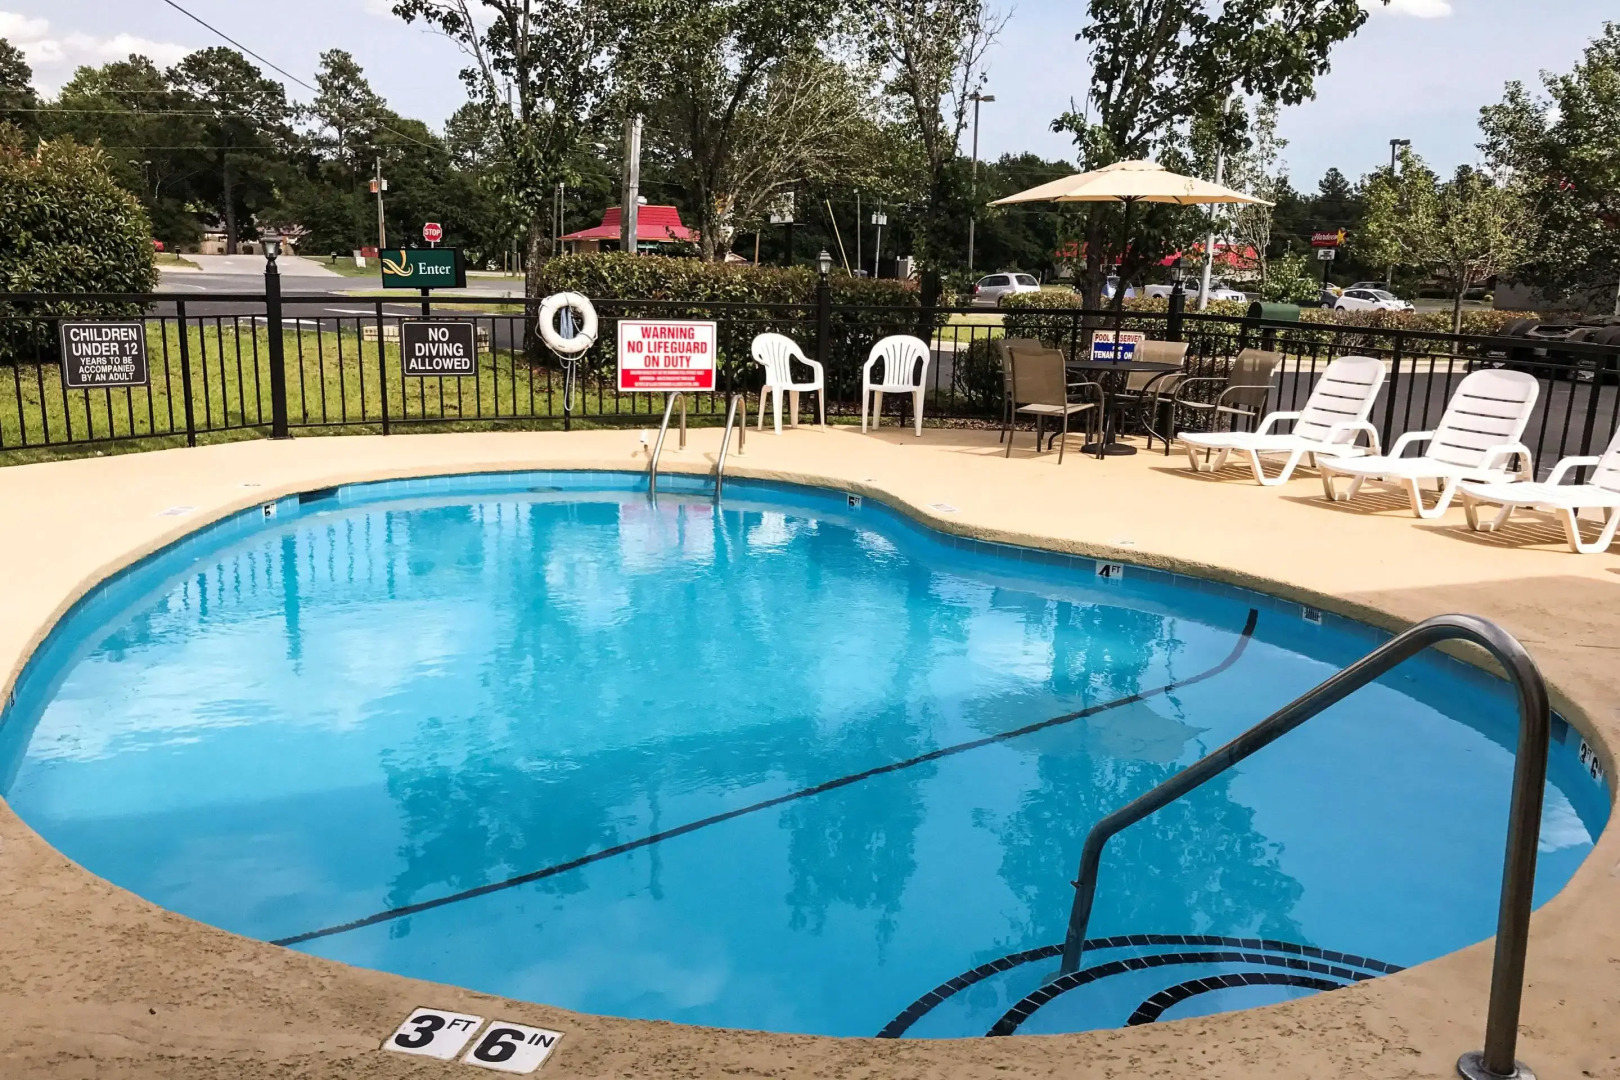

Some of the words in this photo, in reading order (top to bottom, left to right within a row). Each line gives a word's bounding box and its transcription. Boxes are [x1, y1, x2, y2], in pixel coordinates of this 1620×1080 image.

[424, 228, 441, 236] STOP
[418, 262, 451, 275] Enter
[70, 328, 138, 342] CHILDREN
[428, 328, 449, 342] NO
[641, 326, 695, 340] WARNING
[1095, 333, 1110, 342] POOL
[72, 343, 120, 356] UNDER
[124, 343, 138, 355] 12
[415, 343, 464, 356] DIVING
[627, 340, 643, 353] NO
[647, 341, 707, 354] LIFEGUARD
[109, 357, 120, 365] TO
[122, 356, 133, 364] BE
[644, 355, 660, 367] ON
[664, 356, 692, 367] DUTY
[1094, 351, 1121, 360] TENANS
[79, 365, 135, 374] ACCOMPANIED
[409, 358, 470, 370] ALLOWED
[81, 374, 93, 382] BY
[109, 373, 134, 381] ADULT
[849, 496, 855, 506] 5
[264, 505, 271, 516] 5
[1098, 564, 1111, 577] 4
[1111, 565, 1121, 573] FT
[394, 1014, 446, 1049] 3
[446, 1018, 476, 1032] FT
[473, 1028, 526, 1063] 6
[527, 1033, 556, 1048] IN
